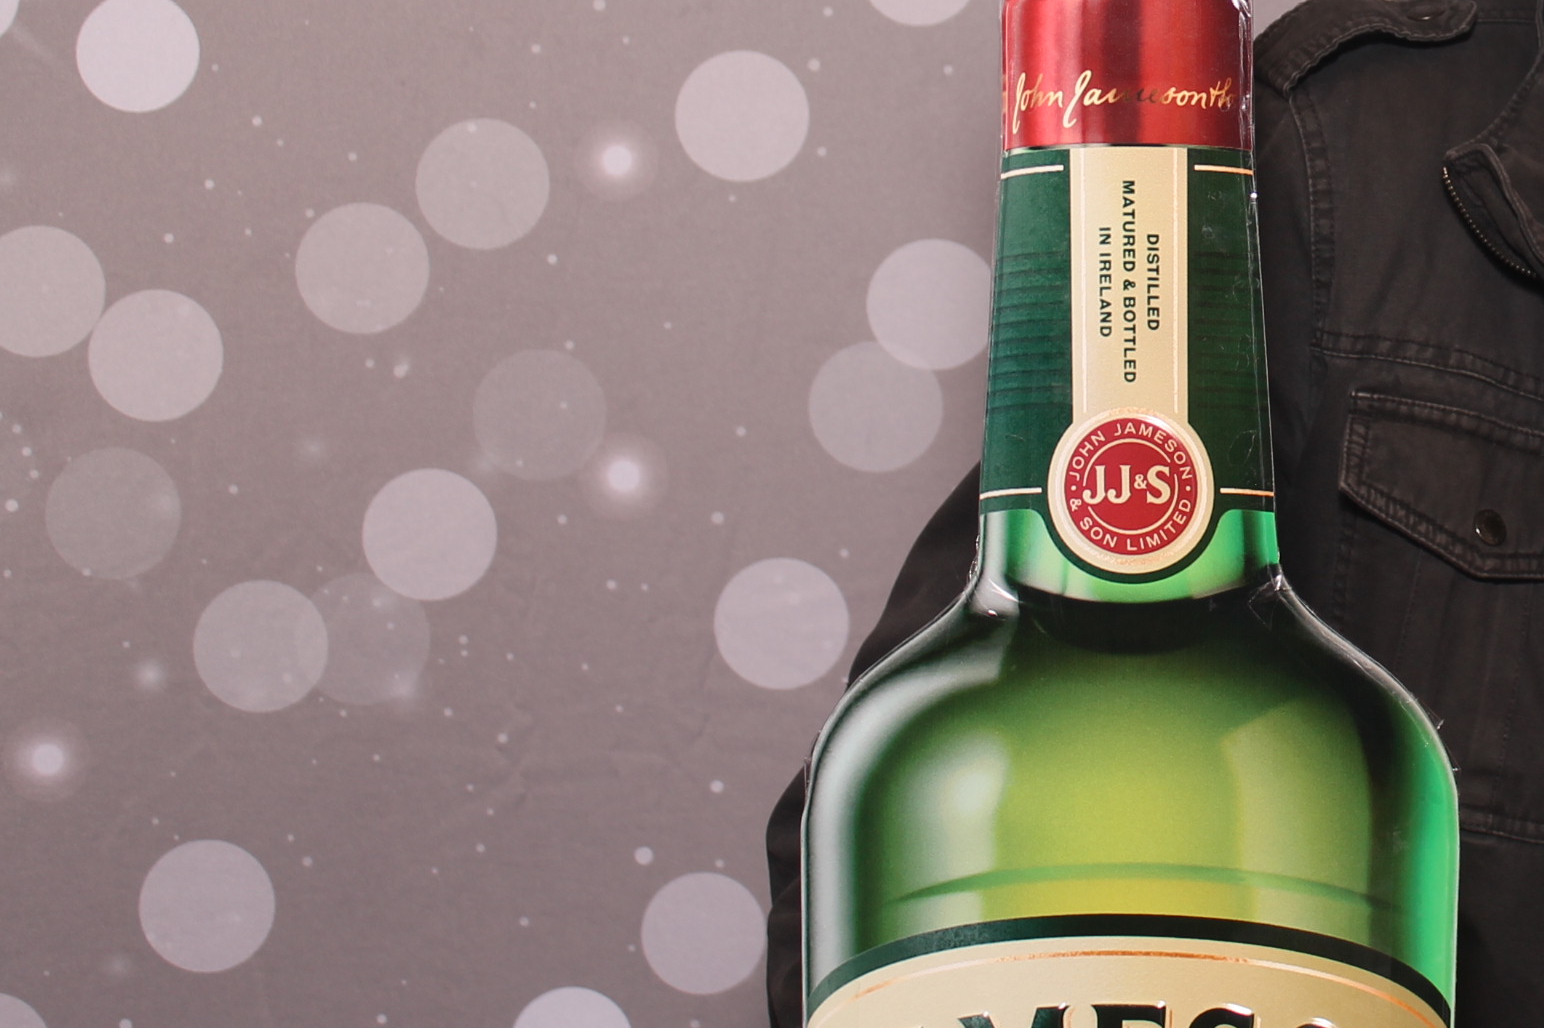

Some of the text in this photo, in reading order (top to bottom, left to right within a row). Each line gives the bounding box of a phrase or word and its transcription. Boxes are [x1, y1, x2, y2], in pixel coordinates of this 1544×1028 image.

[1012, 72, 1064, 134] John
[1099, 227, 1112, 337] IN IRELAND
[1122, 180, 1137, 383] MATURED & BOTTLED
[1146, 233, 1160, 331] DISTILLED
[1069, 422, 1193, 481] JOHN JAMESON
[1082, 464, 1171, 505] JJ&S
[1069, 498, 1191, 551] & SON LIMITED
